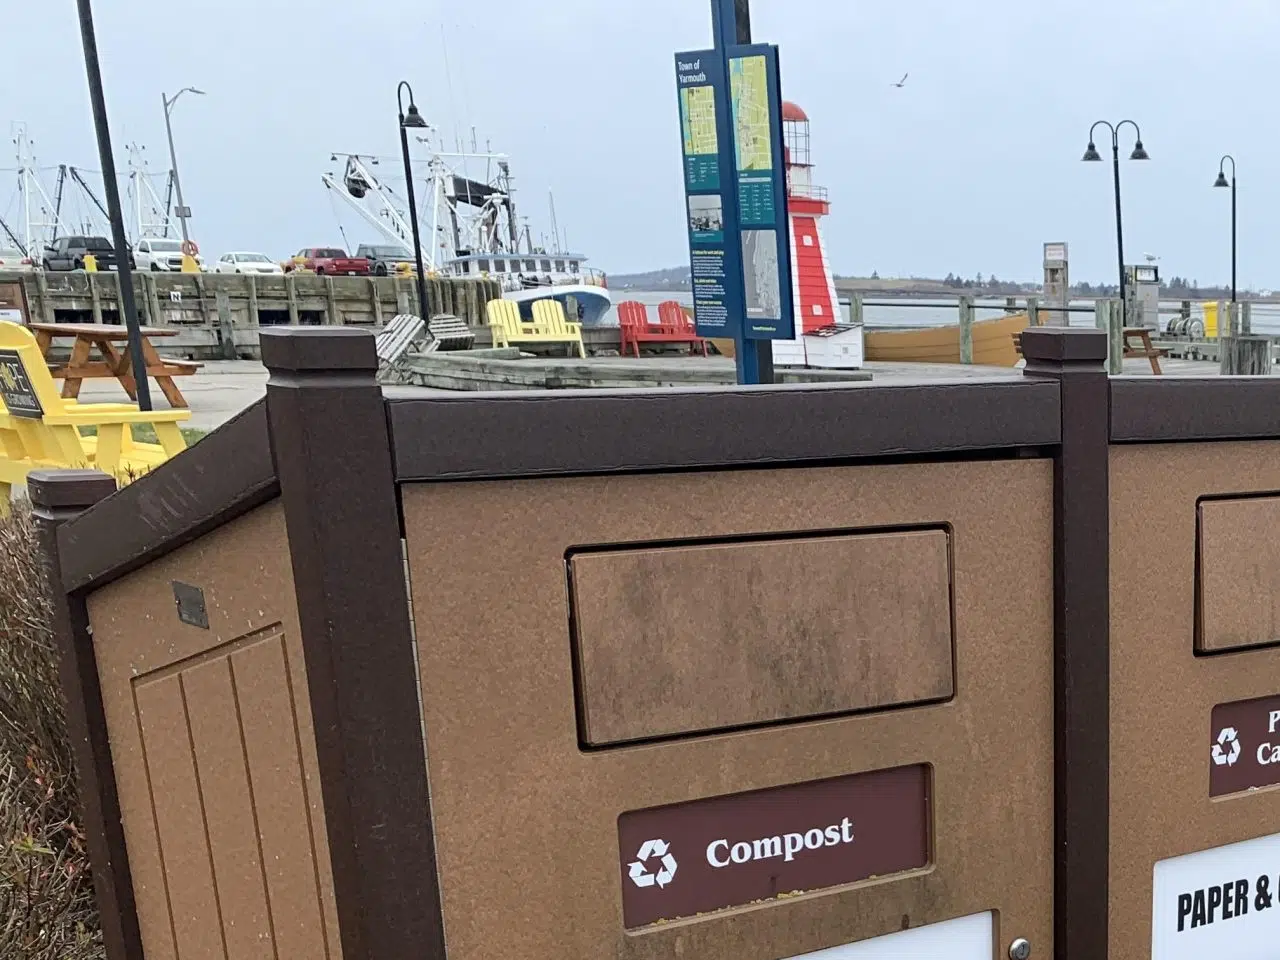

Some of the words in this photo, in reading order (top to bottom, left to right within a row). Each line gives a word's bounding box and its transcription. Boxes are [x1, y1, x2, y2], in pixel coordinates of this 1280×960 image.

[678, 61, 693, 71] Town
[693, 59, 700, 70] of
[679, 71, 706, 83] Yarmouth
[705, 816, 854, 868] Compost
[1177, 878, 1249, 933] PAPER
[1254, 874, 1272, 912] &
